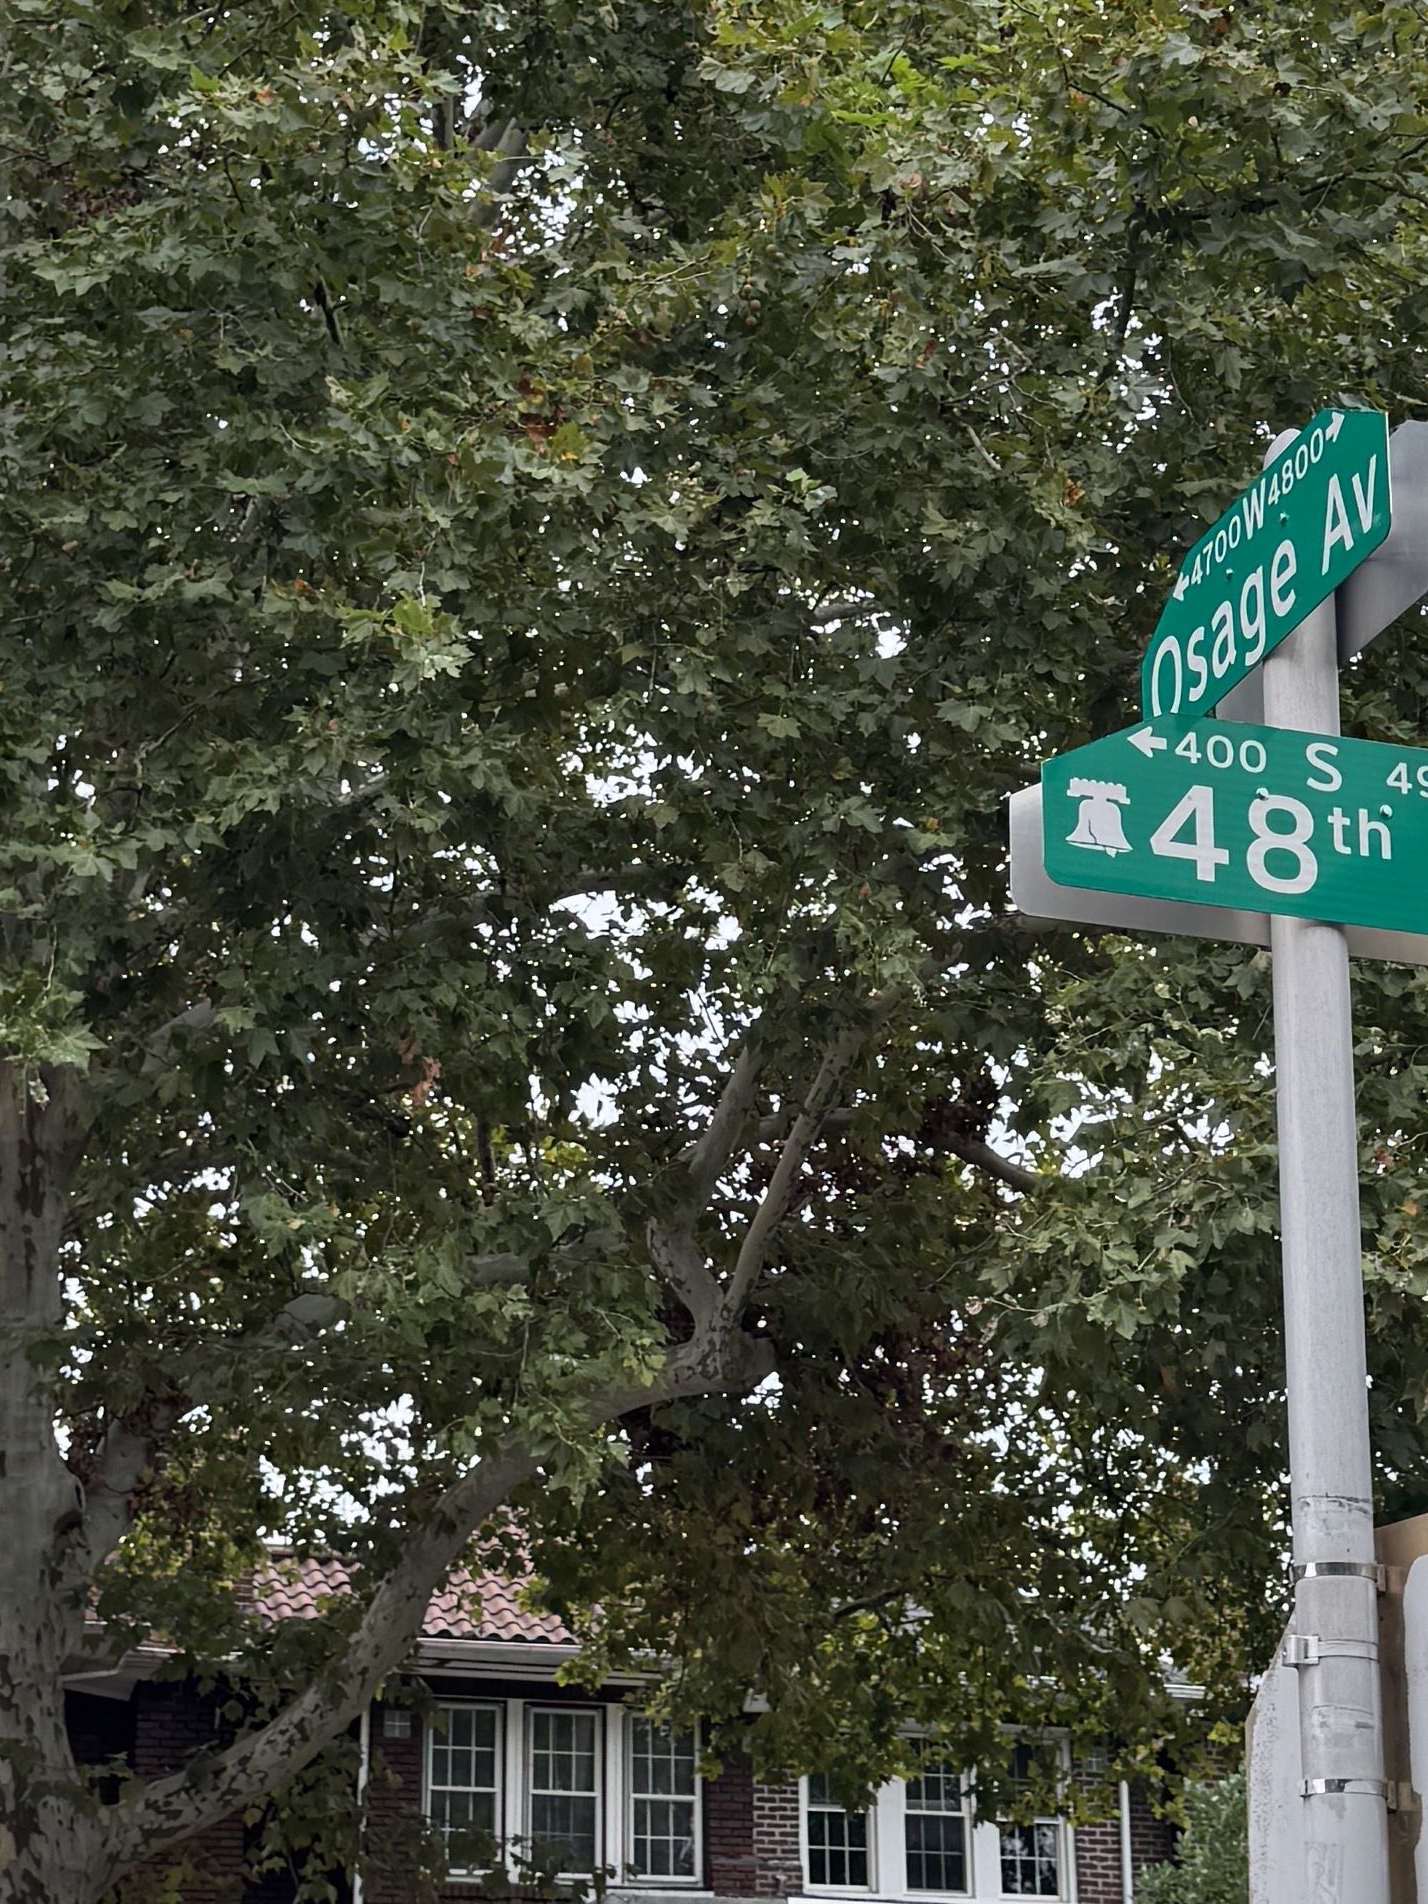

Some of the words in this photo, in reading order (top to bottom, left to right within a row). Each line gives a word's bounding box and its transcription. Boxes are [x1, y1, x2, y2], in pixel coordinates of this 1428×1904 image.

[1190, 514, 1241, 586] 4700
[1242, 477, 1266, 541] W
[1268, 427, 1324, 506] 4800
[1151, 539, 1298, 718] Osage
[1322, 453, 1378, 577] Av
[1174, 731, 1268, 774] 400
[1305, 742, 1343, 793] S
[1149, 784, 1393, 895] 48th
